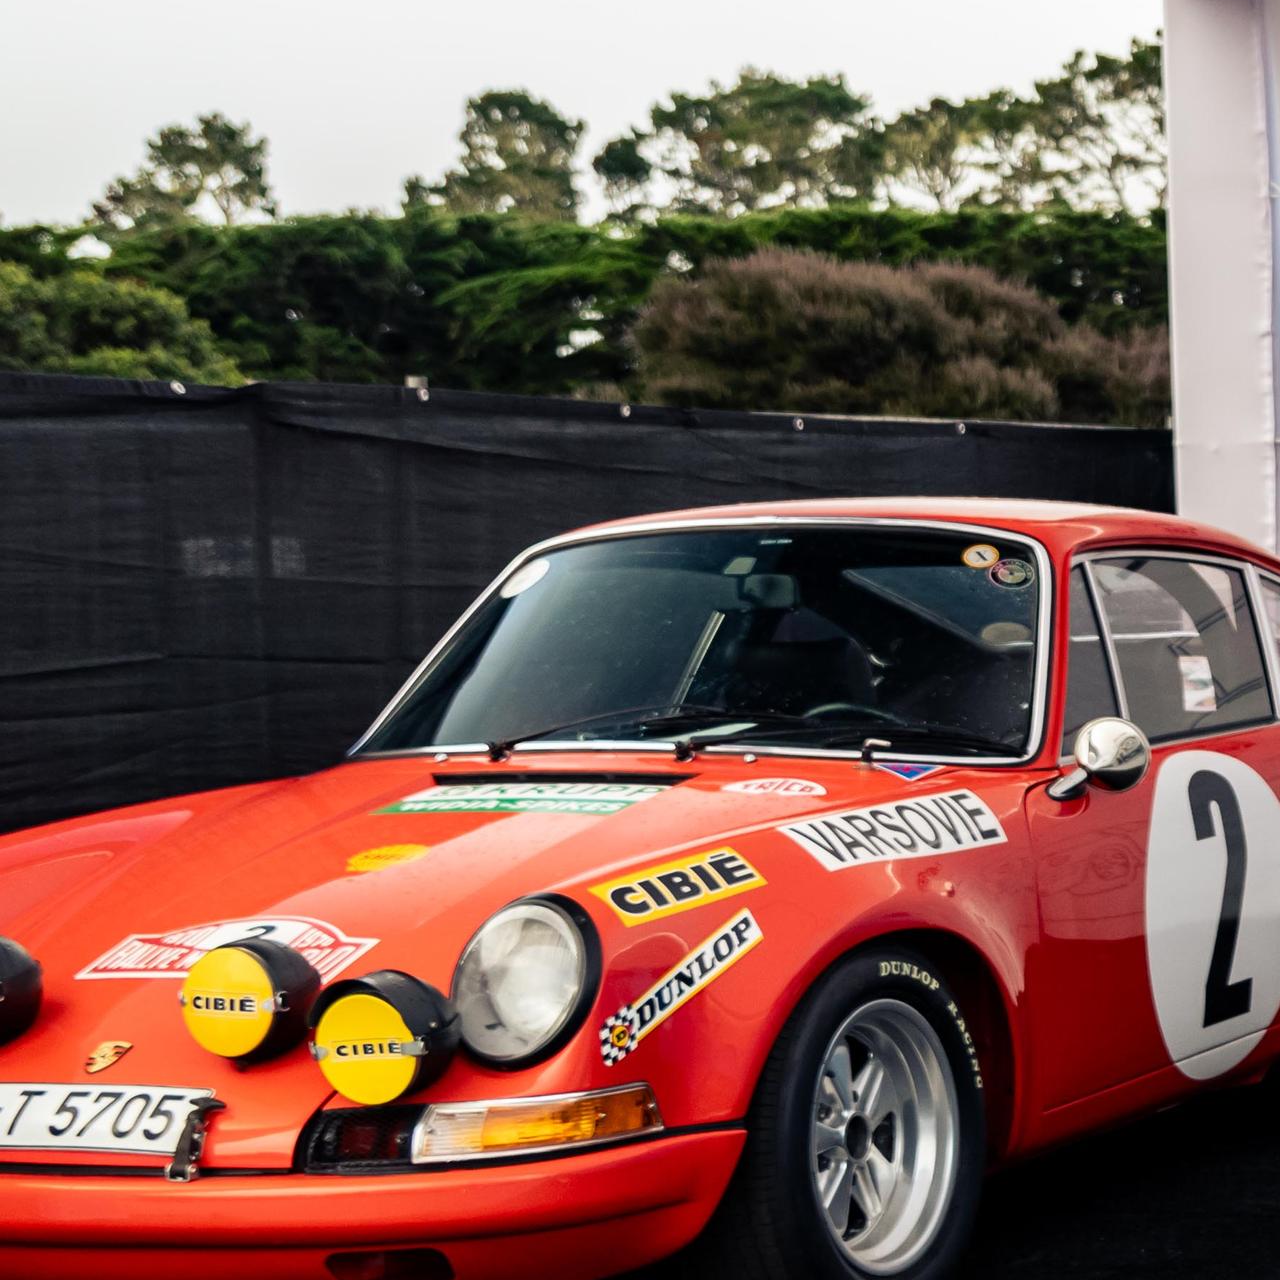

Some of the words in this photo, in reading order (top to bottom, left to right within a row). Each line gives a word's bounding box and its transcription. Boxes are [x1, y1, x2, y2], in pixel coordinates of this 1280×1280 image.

[788, 793, 1000, 863] VARSOVIE
[1187, 769, 1253, 1028] 2
[635, 916, 752, 1032] DUNLOP
[879, 960, 940, 991] DUNLOP
[947, 999, 984, 1089] RACING
[48, 1091, 188, 1140] 5705
